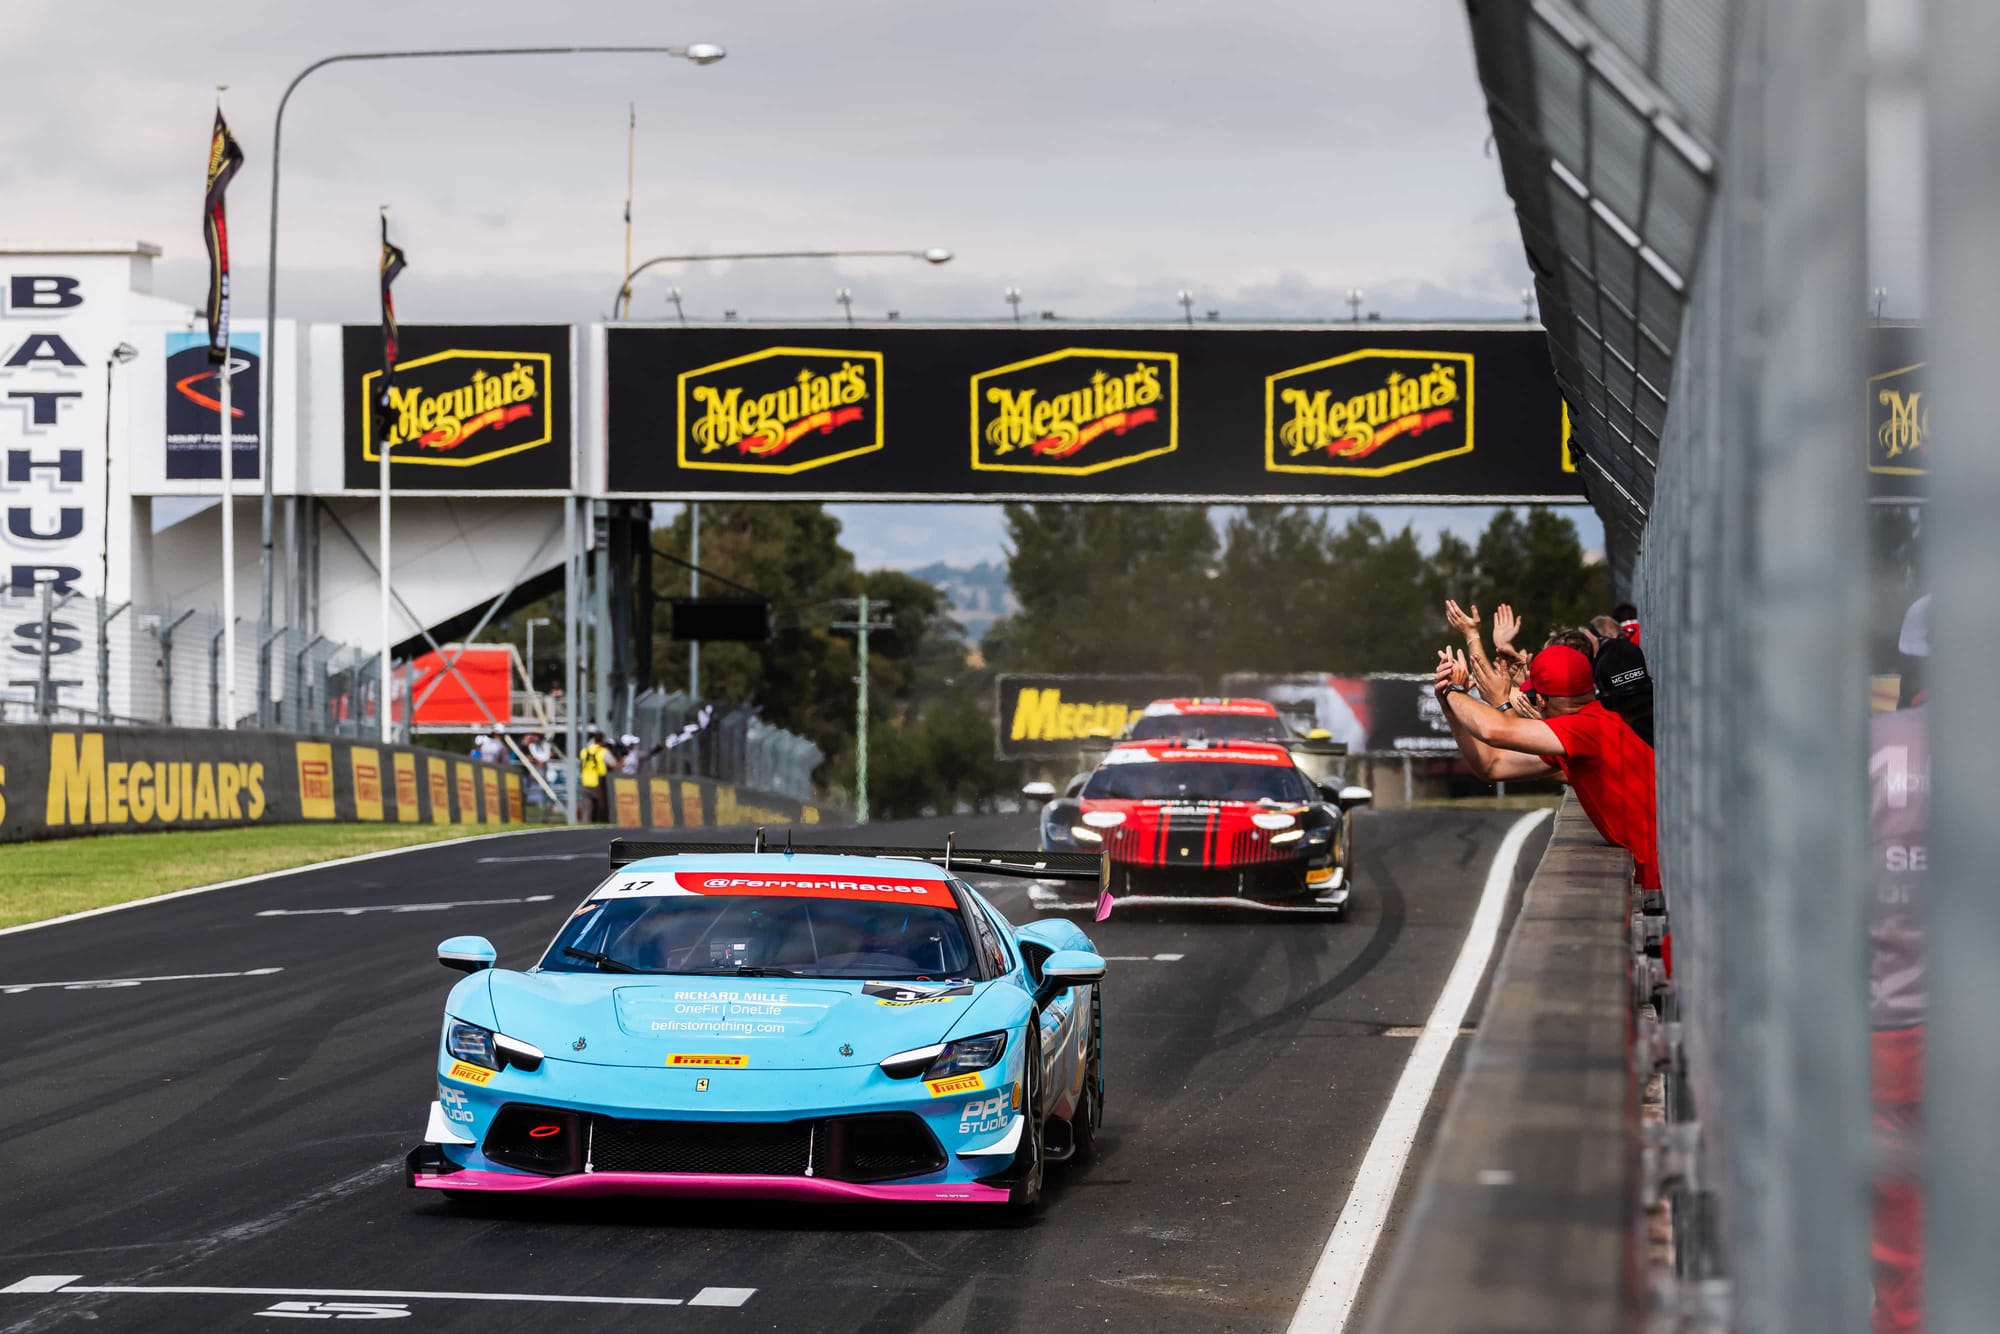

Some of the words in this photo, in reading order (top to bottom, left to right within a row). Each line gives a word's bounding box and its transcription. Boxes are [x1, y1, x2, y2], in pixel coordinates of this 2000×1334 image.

[388, 361, 536, 448] Meguiar's
[692, 361, 867, 454] Meguiar's
[986, 362, 1161, 455] Meguiar's
[1280, 362, 1457, 456] Meguiar's
[4, 275, 86, 713] BATHURST
[1624, 670, 1645, 680] CORSA
[47, 733, 265, 825] MEGUIAR'S
[619, 881, 655, 892] 17
[703, 878, 928, 894] @FerrariRaces
[674, 991, 739, 1000] RICHARD
[743, 993, 788, 1003] MILLE
[674, 1004, 719, 1014] OneFit
[730, 1004, 782, 1016] OneLife
[673, 1055, 742, 1065] PIRELLI
[452, 1064, 490, 1083] PIRELLI
[932, 1076, 979, 1093] PIRELLI
[961, 1093, 1010, 1122] PPF
[958, 1115, 1008, 1134] STUDIO
